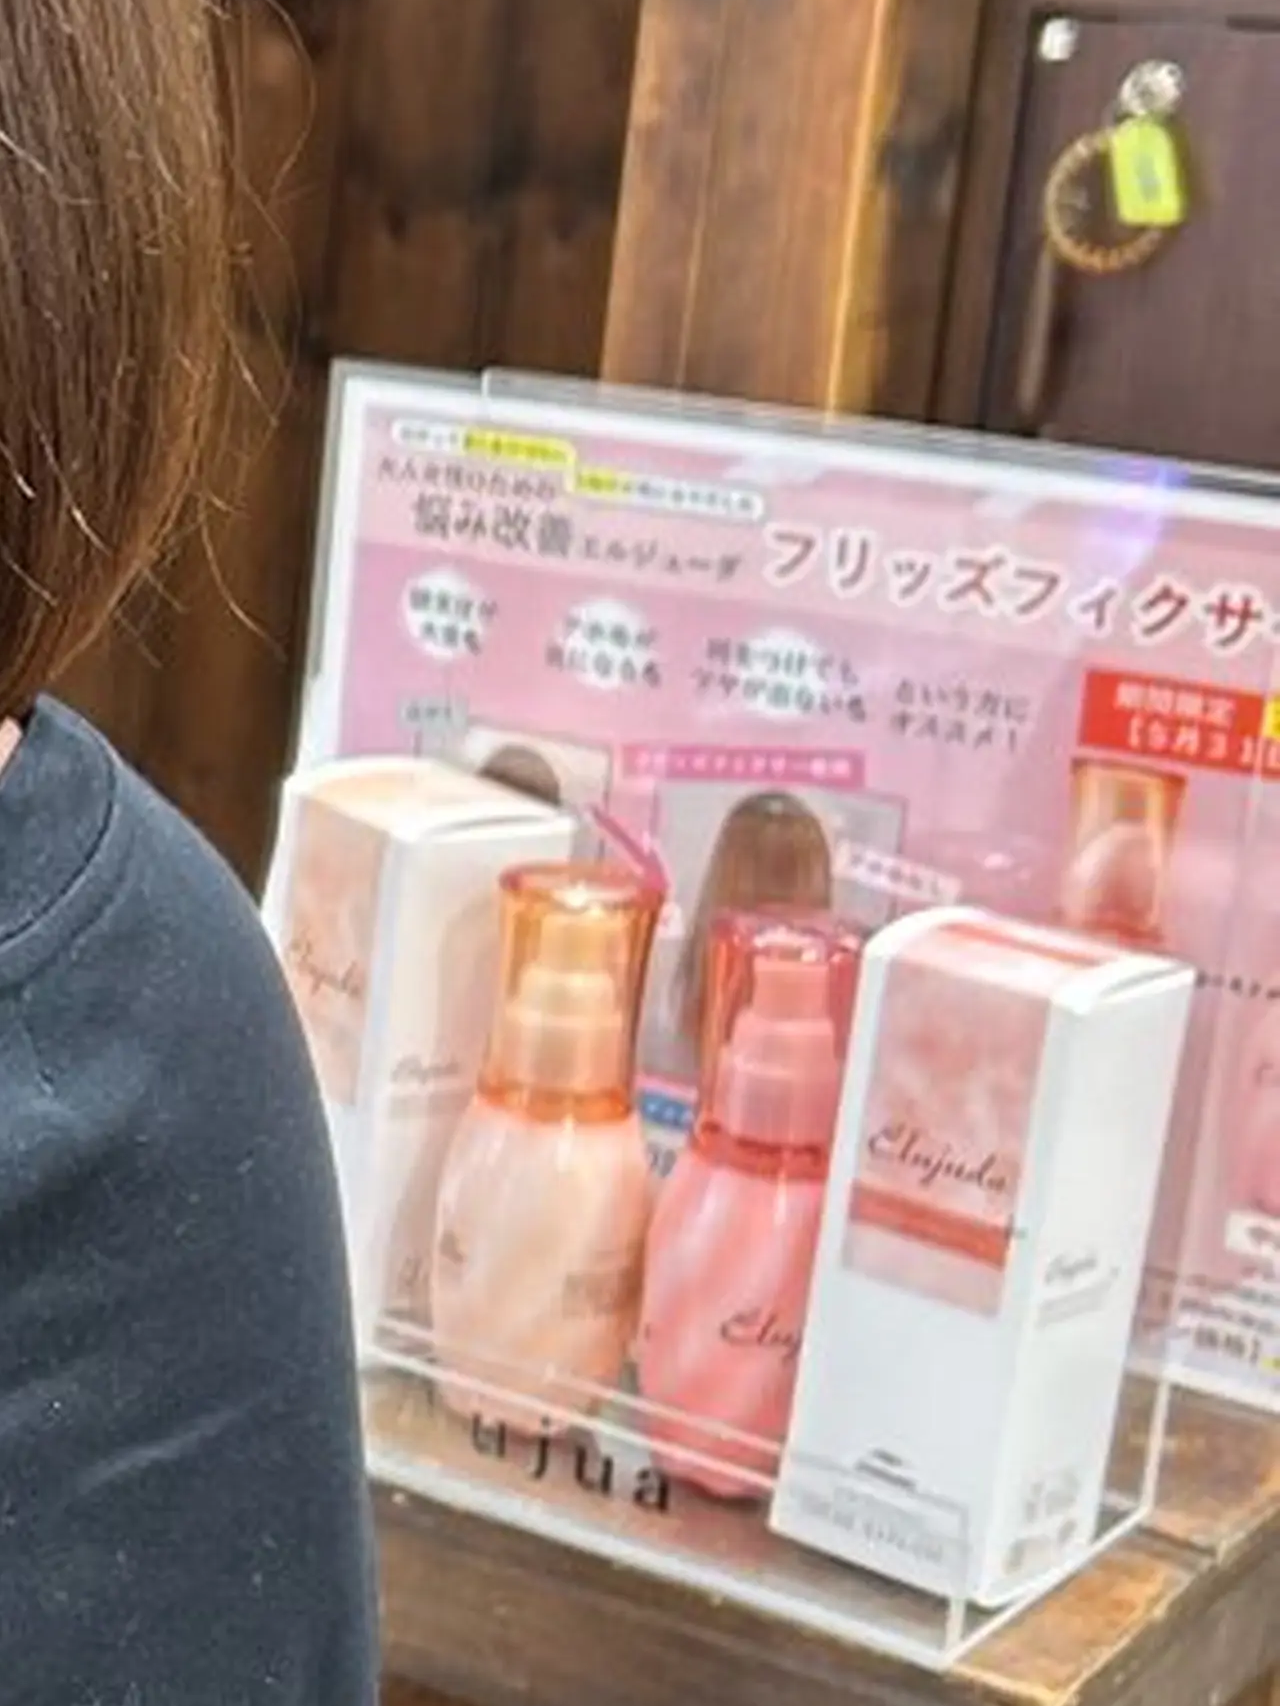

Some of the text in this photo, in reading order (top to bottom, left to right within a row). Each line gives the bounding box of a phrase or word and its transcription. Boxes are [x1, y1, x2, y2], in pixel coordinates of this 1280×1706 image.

[771, 529, 1280, 647] フリッズフィクサ
